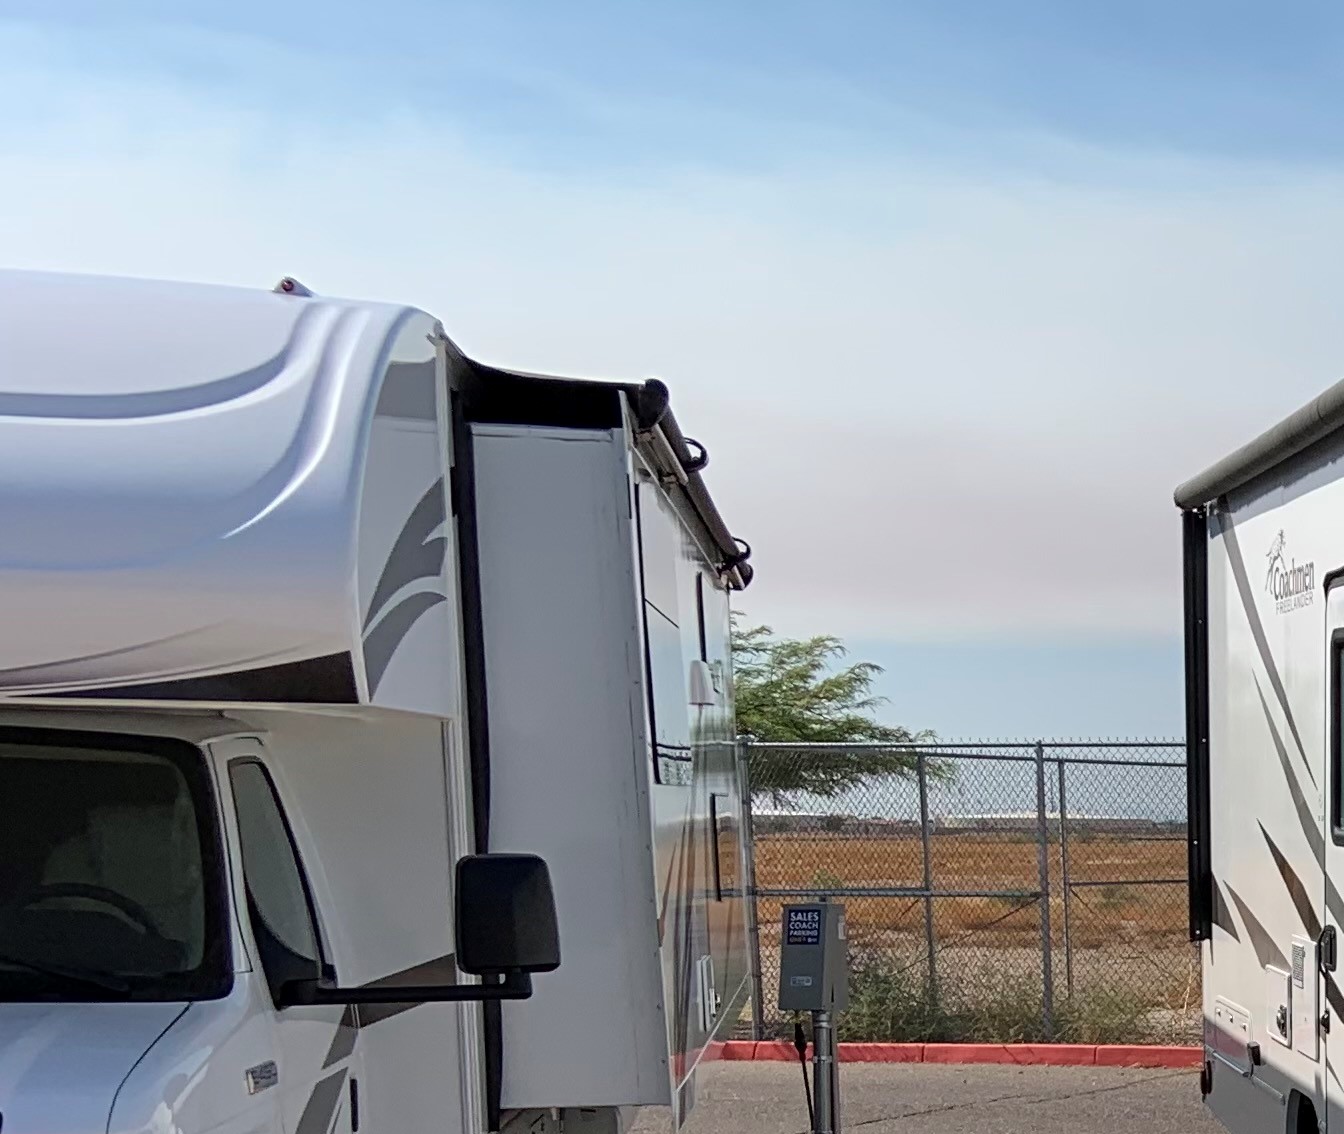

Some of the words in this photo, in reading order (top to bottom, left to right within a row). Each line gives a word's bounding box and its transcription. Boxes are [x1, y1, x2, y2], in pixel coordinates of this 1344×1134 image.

[1274, 557, 1315, 601] Coachmen
[1275, 591, 1314, 616] FREELANDER
[790, 912, 819, 921] SALES
